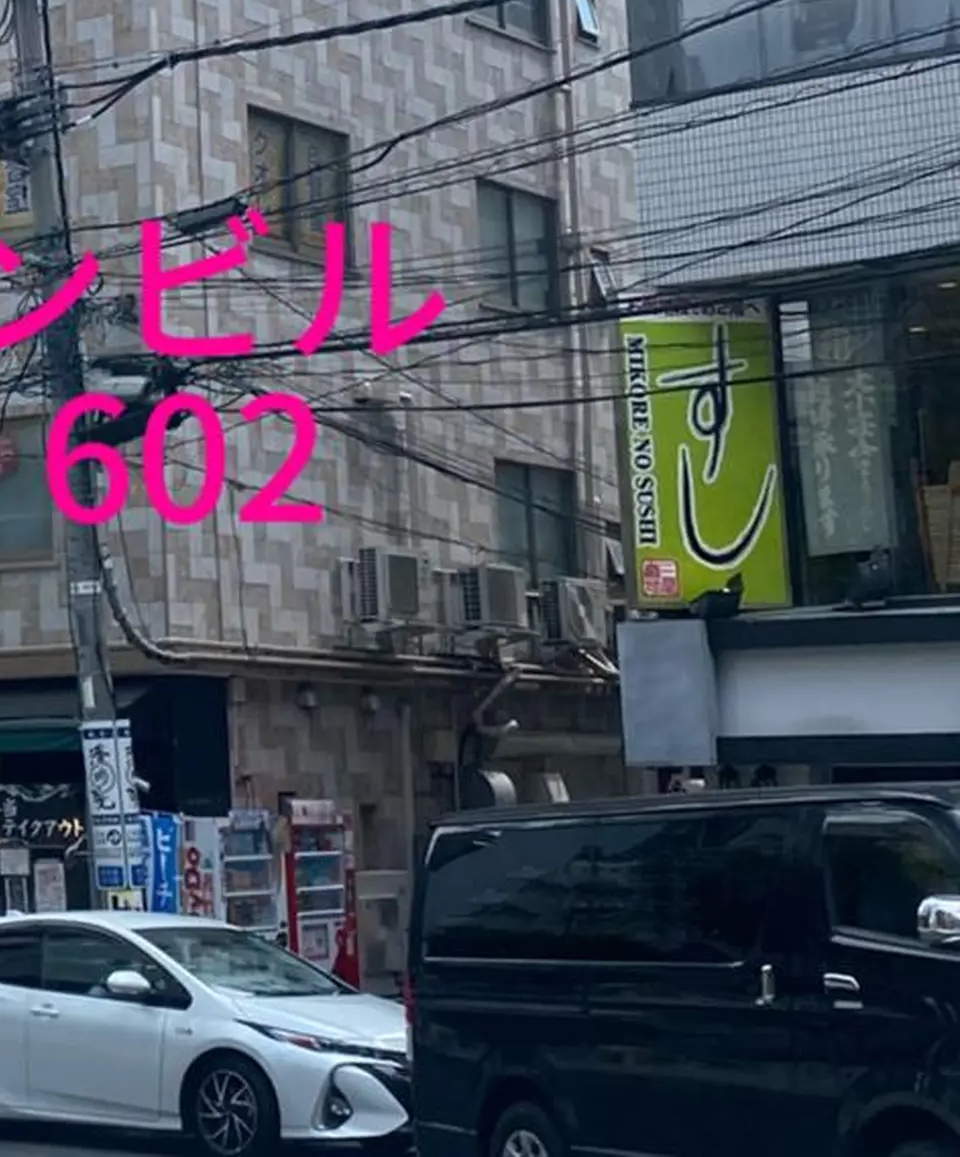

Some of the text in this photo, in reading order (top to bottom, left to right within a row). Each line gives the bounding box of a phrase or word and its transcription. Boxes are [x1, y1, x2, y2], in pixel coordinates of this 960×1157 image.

[631, 436, 653, 470] NO
[657, 322, 778, 571] すし
[634, 475, 658, 545] SUSHI
[2, 818, 85, 838] テイクアウト
